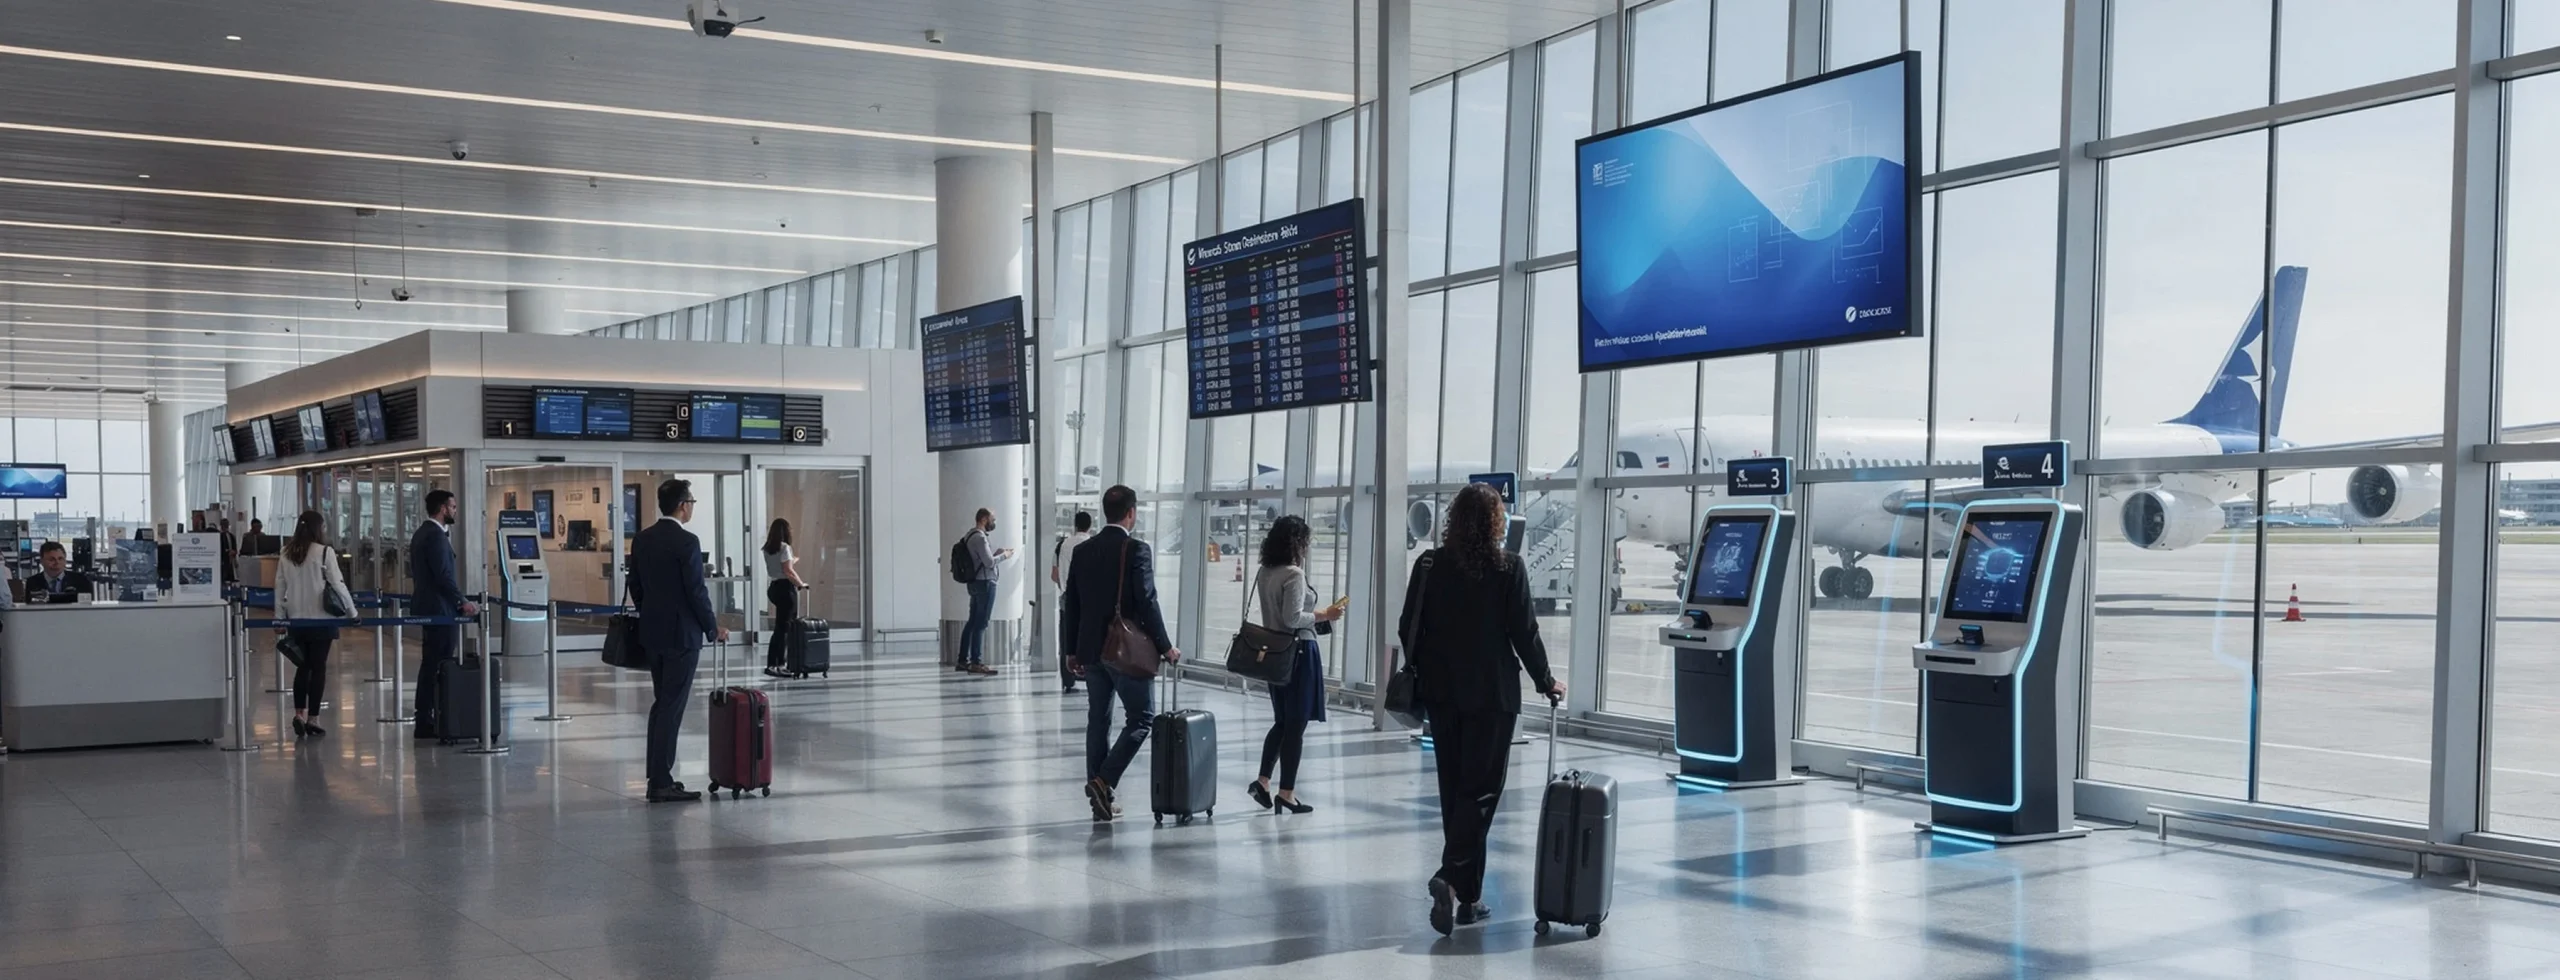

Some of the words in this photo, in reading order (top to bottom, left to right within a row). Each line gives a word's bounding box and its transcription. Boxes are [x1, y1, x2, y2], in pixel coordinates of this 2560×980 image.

[505, 422, 513, 435] 1
[2041, 452, 2054, 479] 4
[1770, 467, 1780, 489] 3
[1501, 481, 1509, 498] 4
